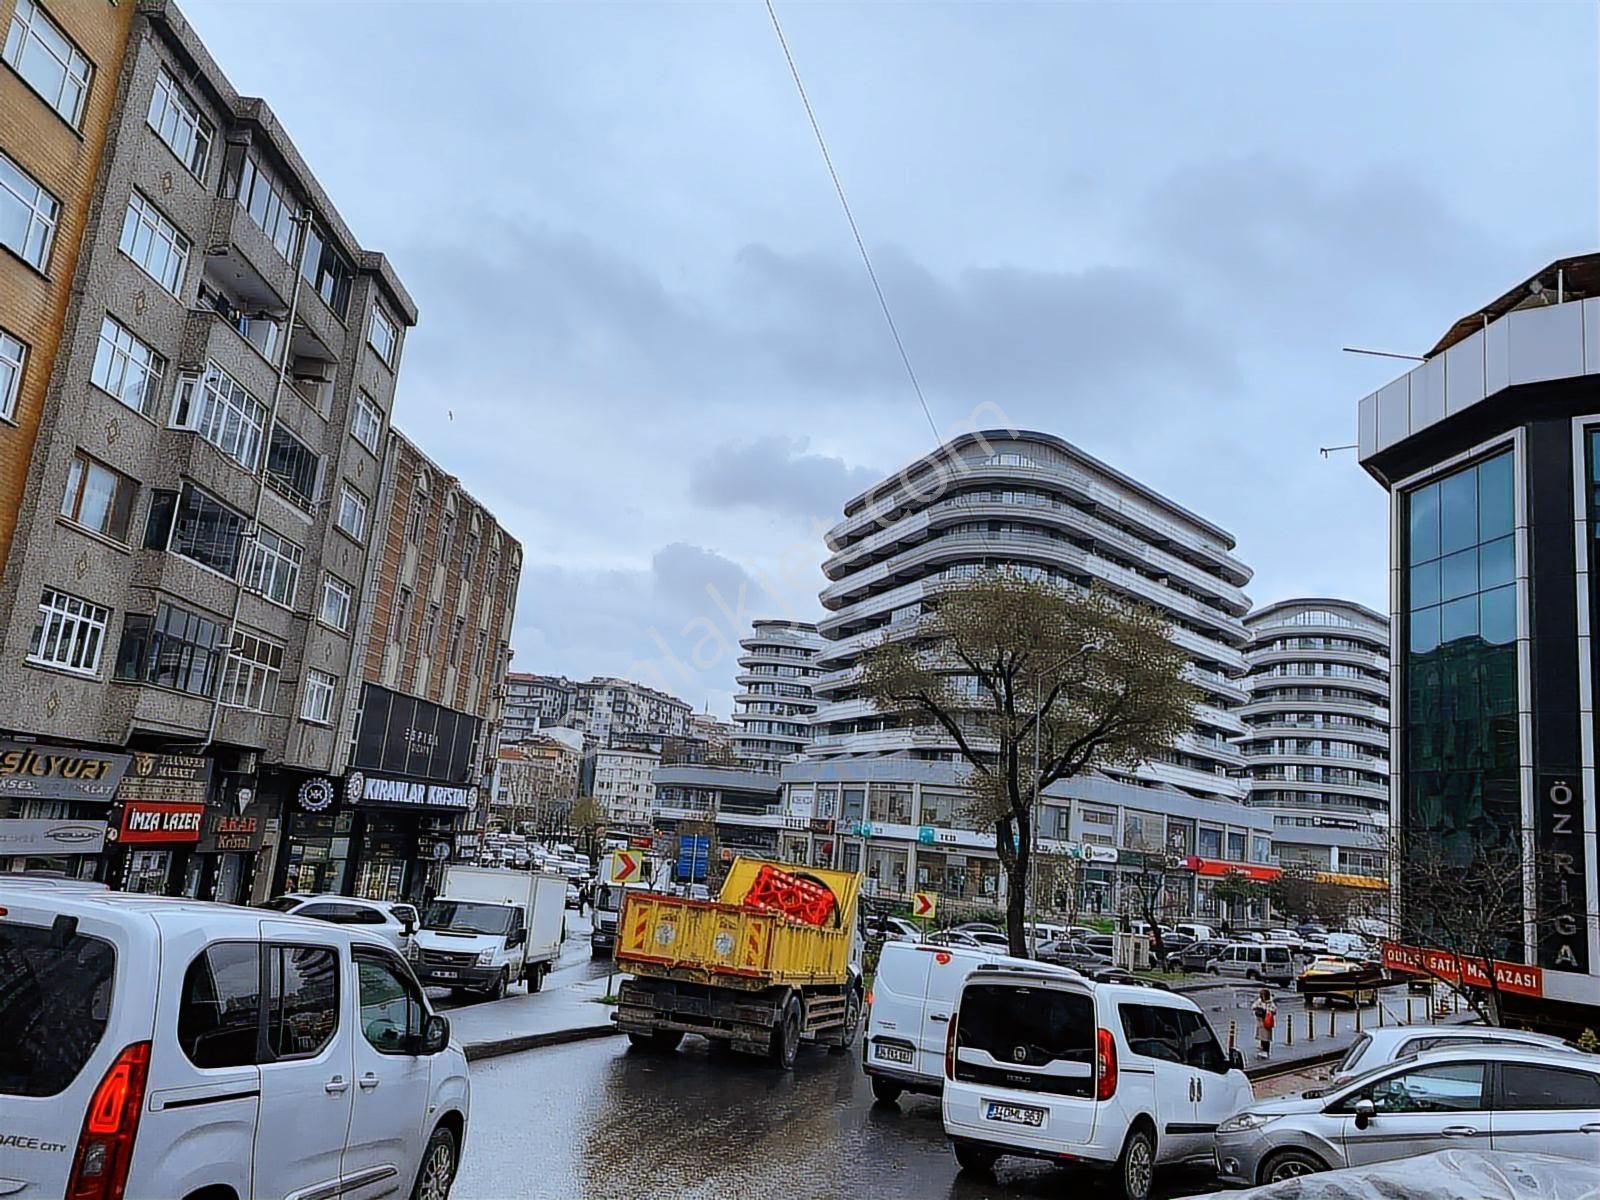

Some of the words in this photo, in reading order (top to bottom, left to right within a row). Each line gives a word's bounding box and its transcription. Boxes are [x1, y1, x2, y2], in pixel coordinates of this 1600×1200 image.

[363, 778, 426, 804] KIRANLAR
[129, 808, 160, 831] İMZA
[163, 812, 201, 831] LAZER
[1430, 957, 1462, 973] SATI
[1467, 963, 1536, 988] MAAZASI
[40, 1142, 67, 1152] CITY
